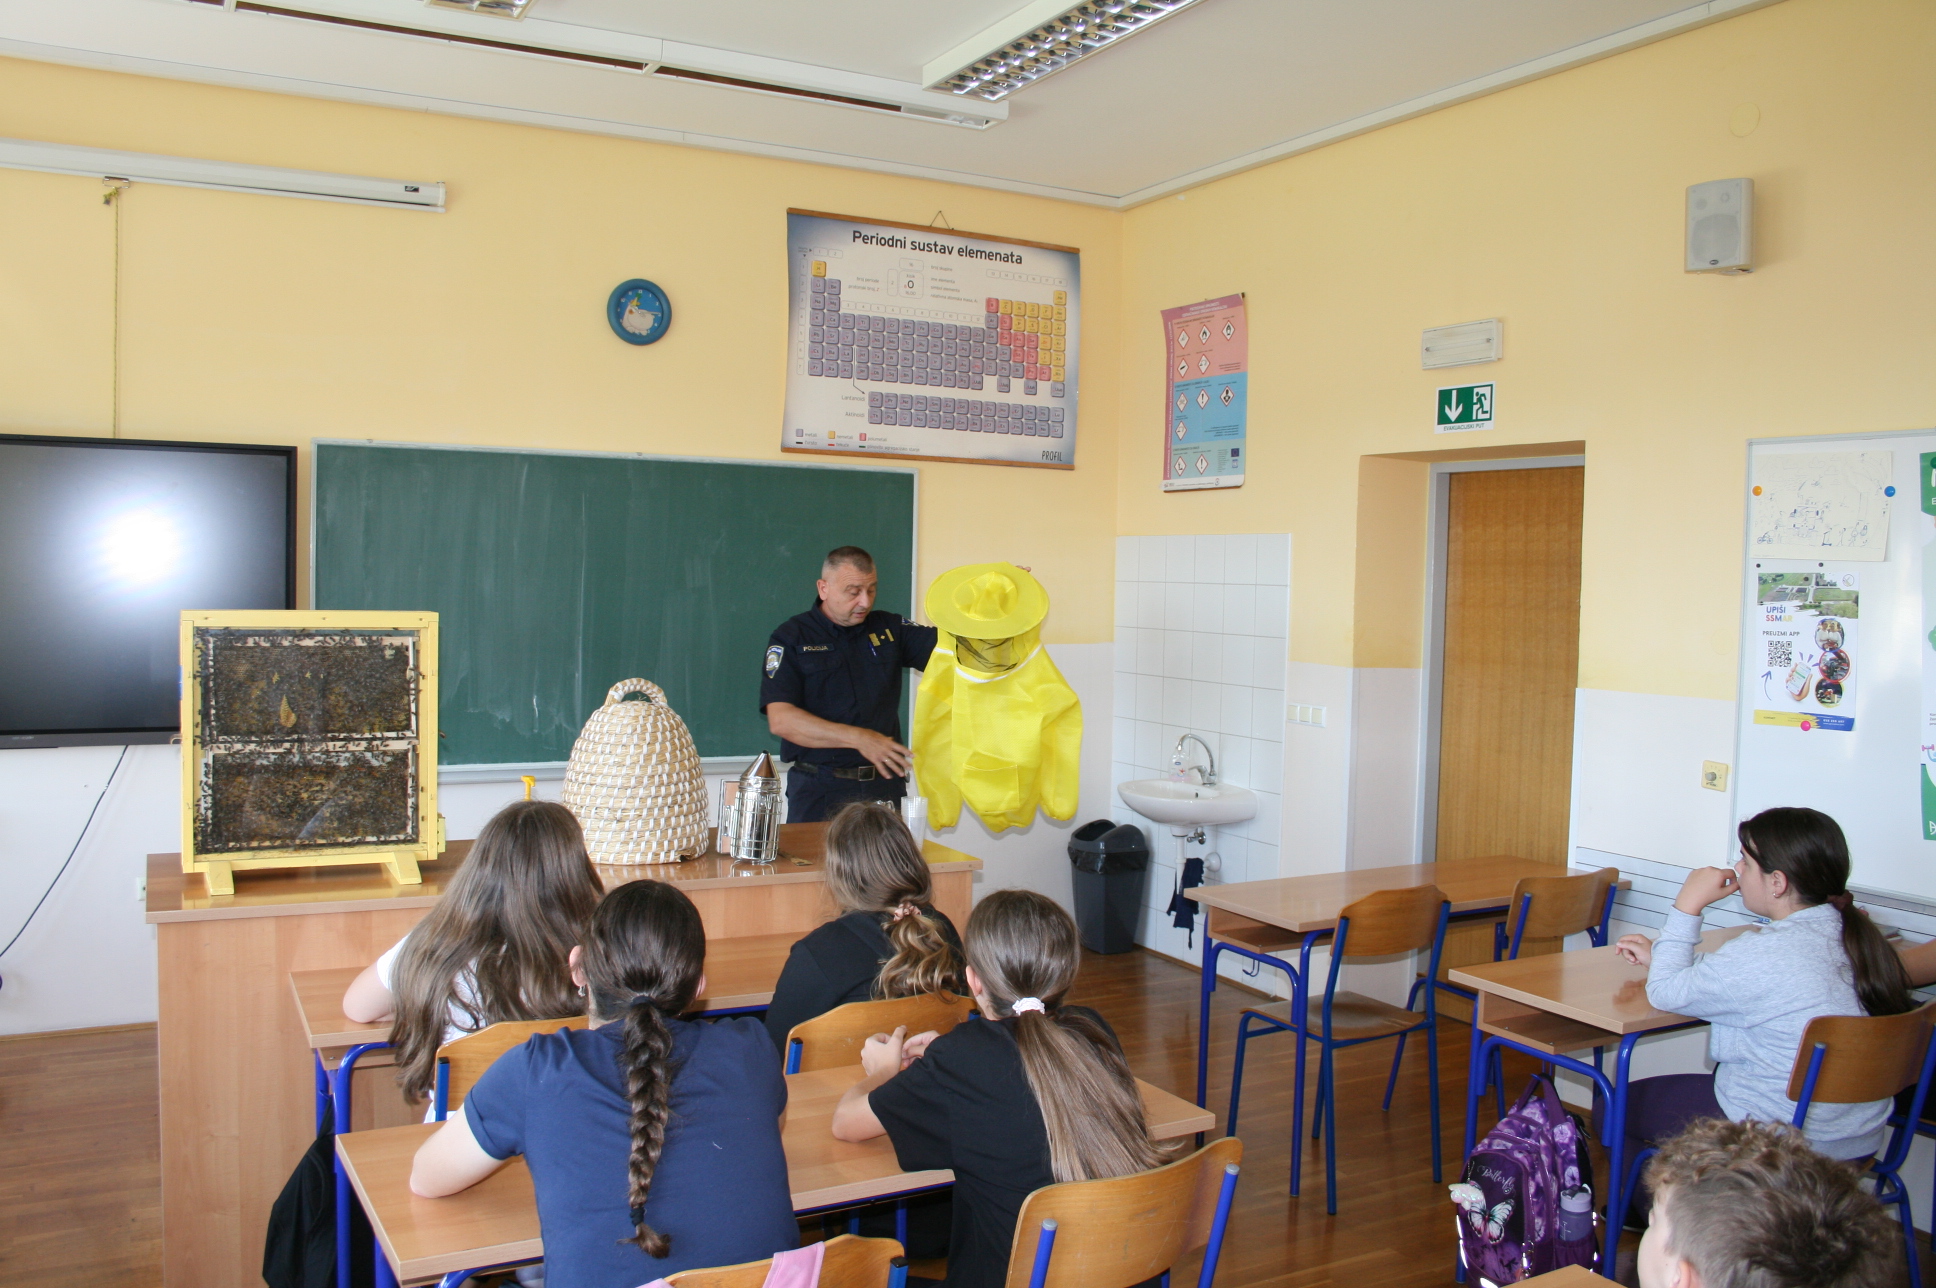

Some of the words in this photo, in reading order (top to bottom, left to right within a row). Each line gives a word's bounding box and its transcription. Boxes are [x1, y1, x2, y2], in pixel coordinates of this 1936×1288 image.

[852, 230, 906, 249] Periodni
[910, 240, 954, 255] sustav
[957, 245, 1022, 264] elemenata
[1041, 450, 1062, 461] PROFIL
[1766, 605, 1786, 614] UPIŠI
[1765, 614, 1793, 622] SSMAR
